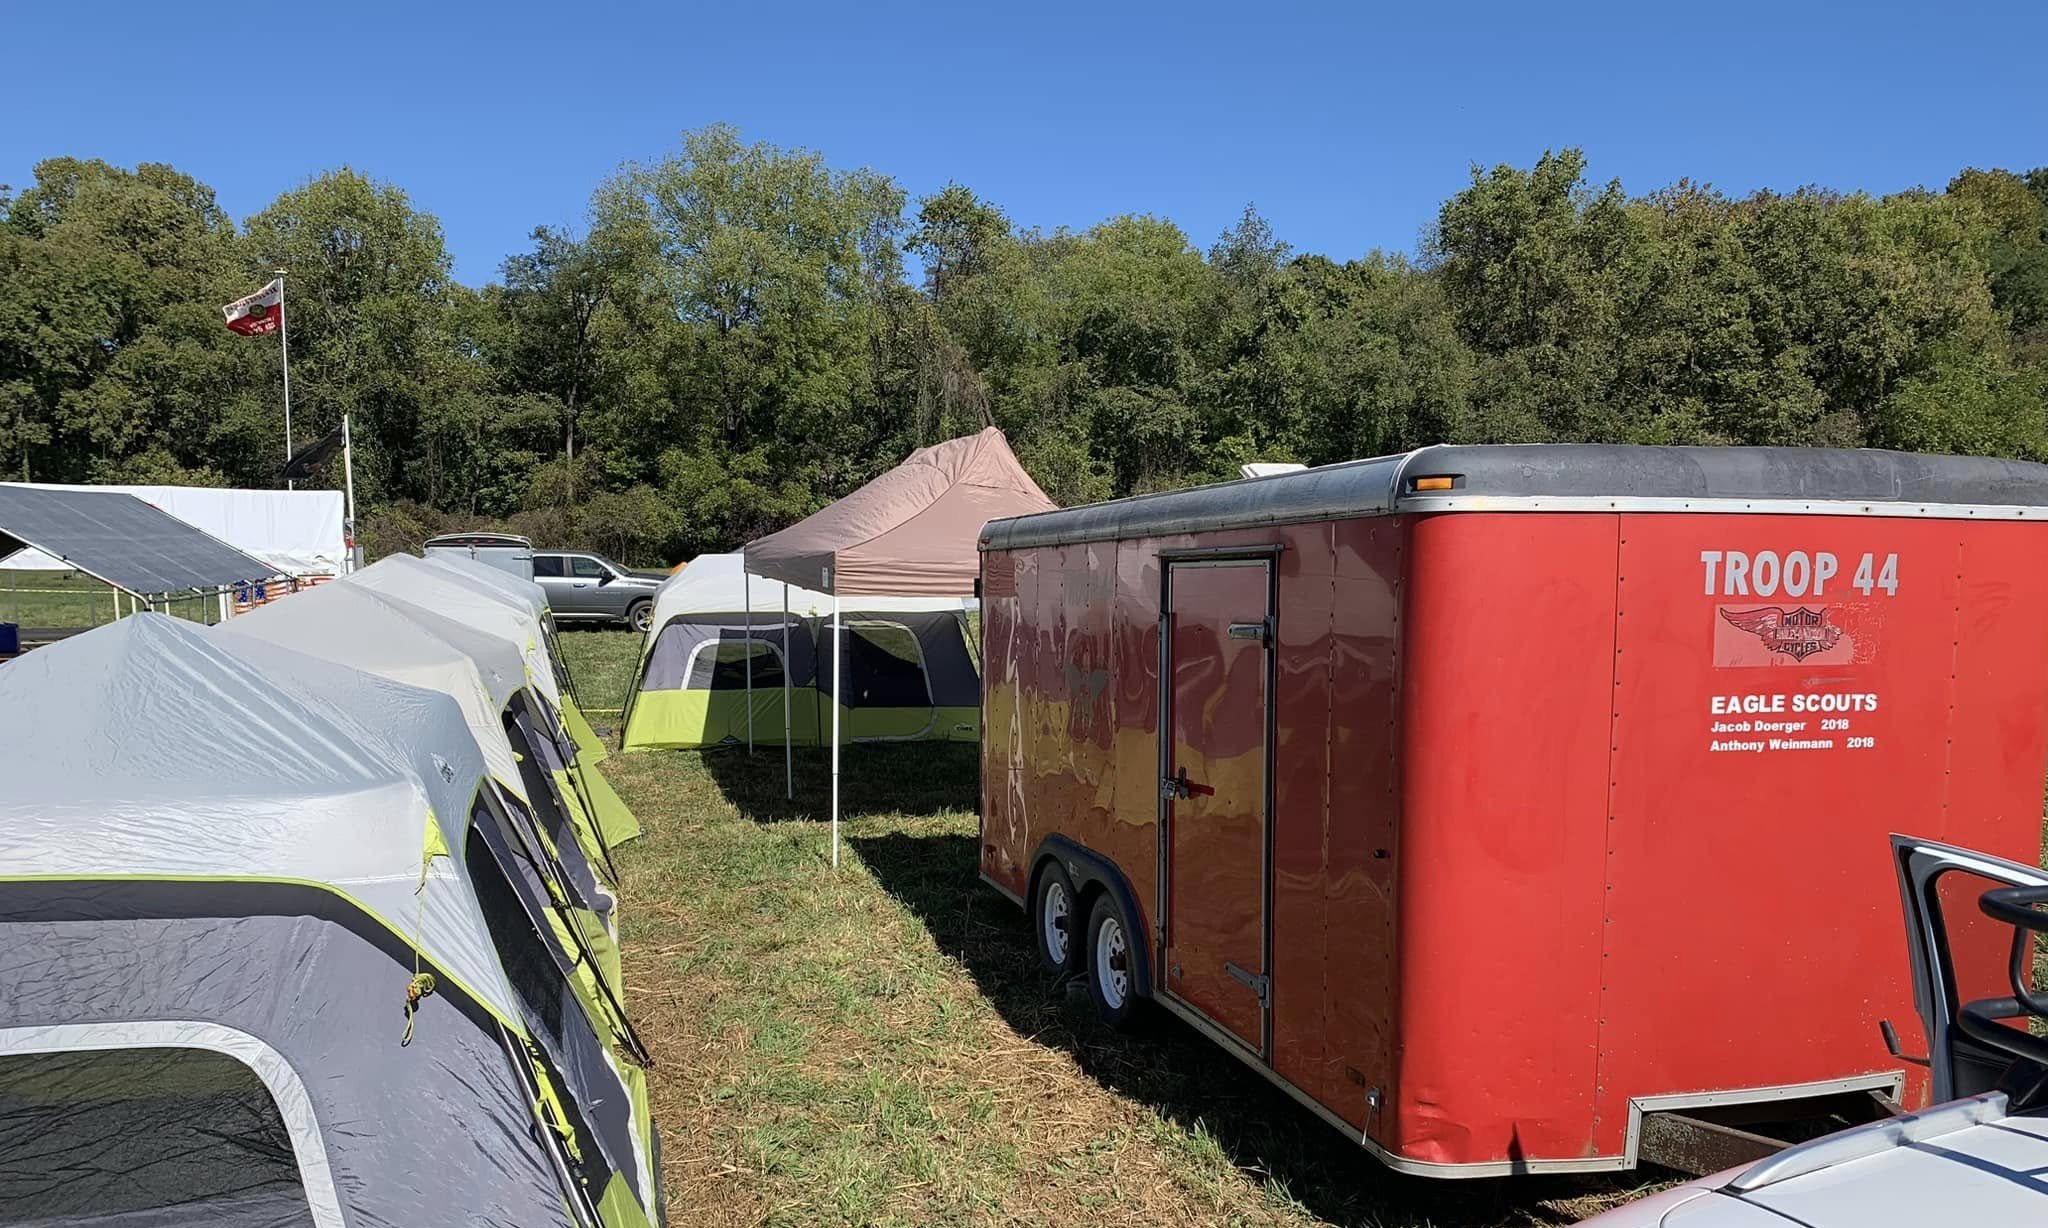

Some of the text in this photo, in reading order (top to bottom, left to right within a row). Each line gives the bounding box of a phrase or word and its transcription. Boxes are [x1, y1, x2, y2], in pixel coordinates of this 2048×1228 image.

[1701, 550, 1898, 597] TROOP 44
[1784, 611, 1819, 626] MOTOR
[1783, 641, 1817, 657] CYCLES
[1711, 694, 1878, 714] EAGLE SCOUTS
[1710, 719, 1849, 733] Jacob Doerger 2018
[1710, 737, 1874, 753] Anthony Weinmann 2018
